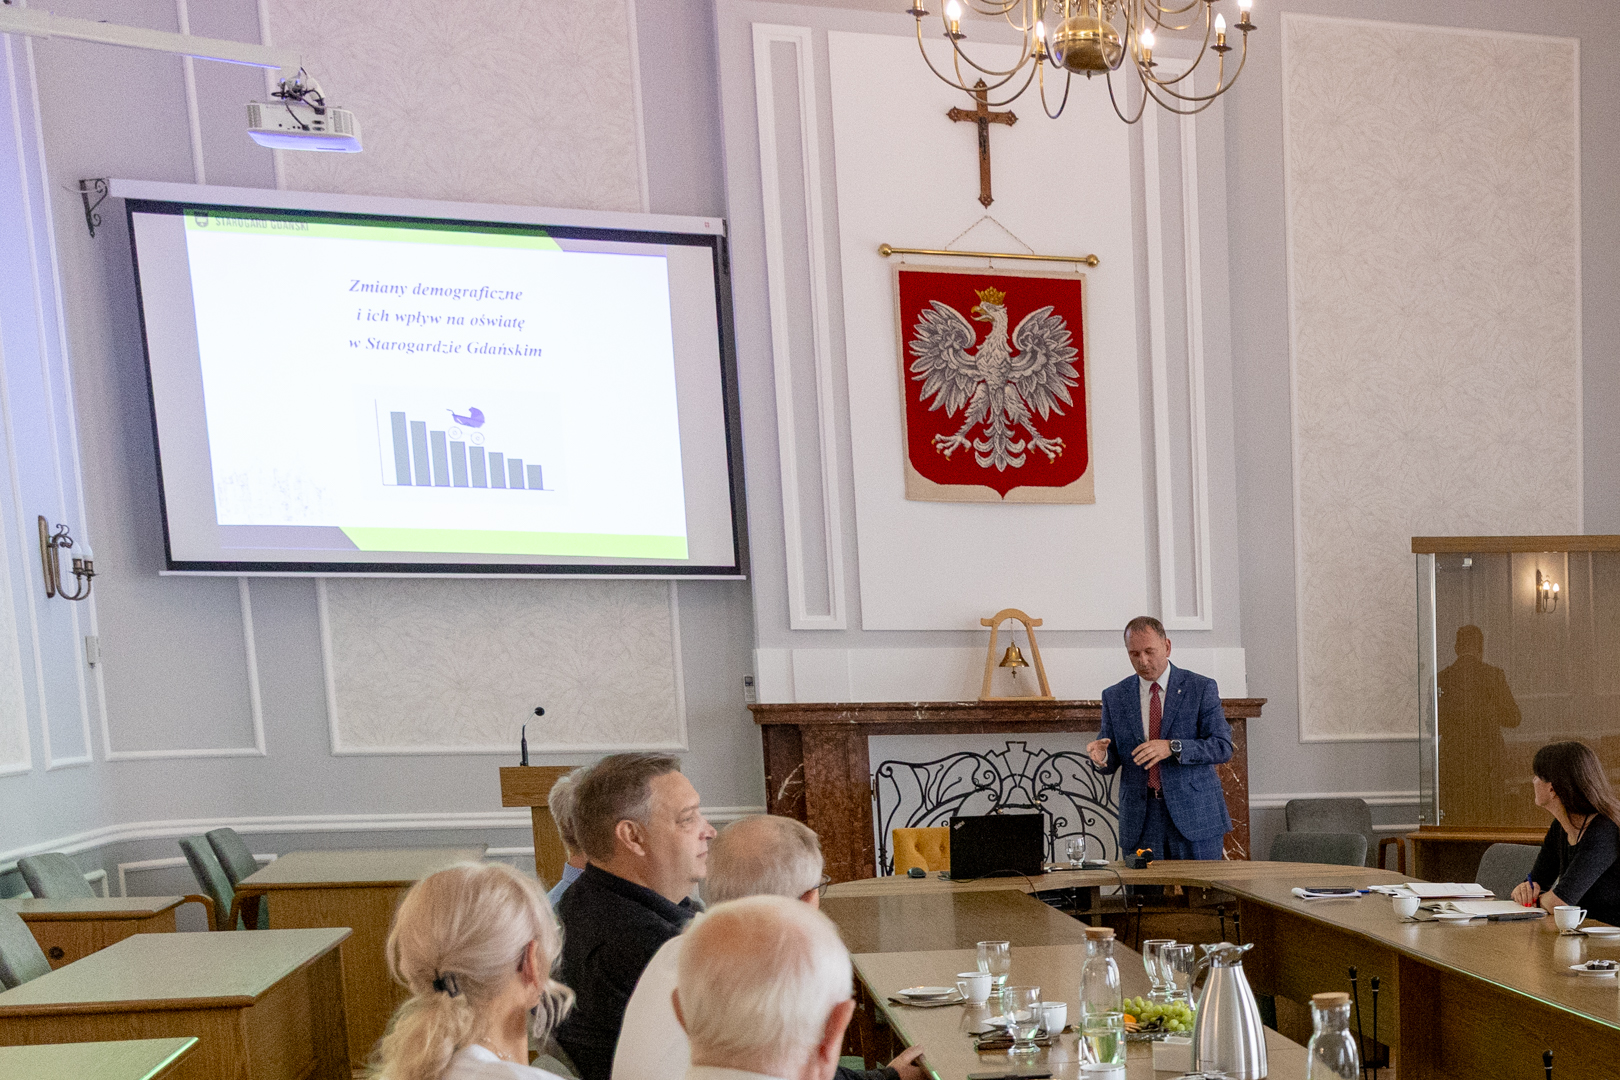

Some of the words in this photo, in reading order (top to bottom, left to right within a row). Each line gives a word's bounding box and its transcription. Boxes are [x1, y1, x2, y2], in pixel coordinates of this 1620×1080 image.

[349, 279, 407, 297] Zmiany
[412, 282, 523, 301] demograficzne
[356, 308, 362, 321] i
[366, 309, 389, 322] ich
[395, 311, 442, 327] wpływ
[446, 315, 465, 326] na
[470, 314, 525, 332] oświatę
[349, 338, 361, 349] w
[365, 337, 462, 355] Starogardzie
[466, 341, 543, 357] Gdańskim
